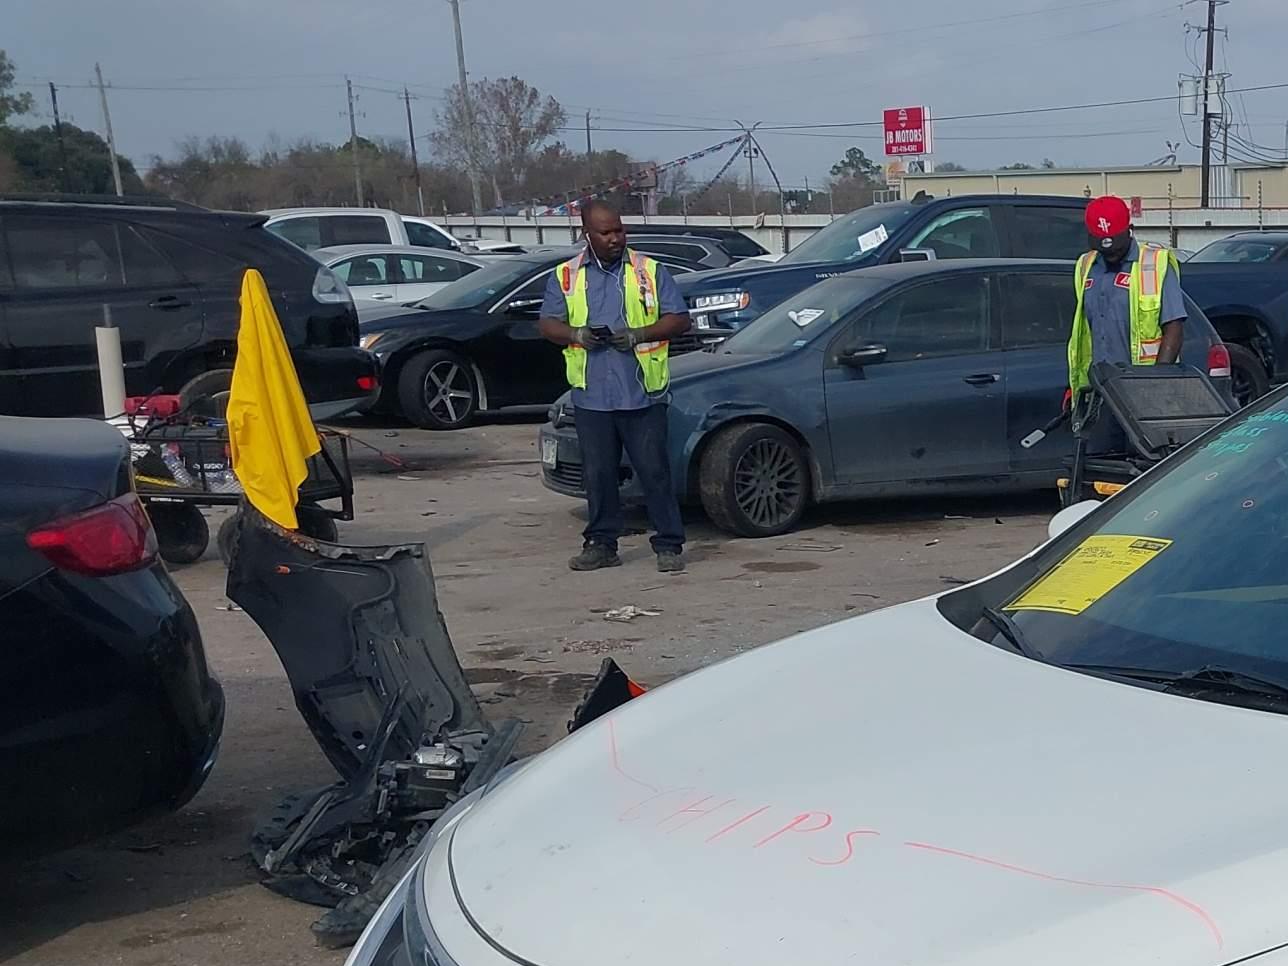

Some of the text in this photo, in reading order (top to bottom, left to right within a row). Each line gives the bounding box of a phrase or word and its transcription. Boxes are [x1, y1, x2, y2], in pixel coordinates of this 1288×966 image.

[886, 129, 922, 144] JB MOTORS
[618, 786, 881, 865] CHIPS
